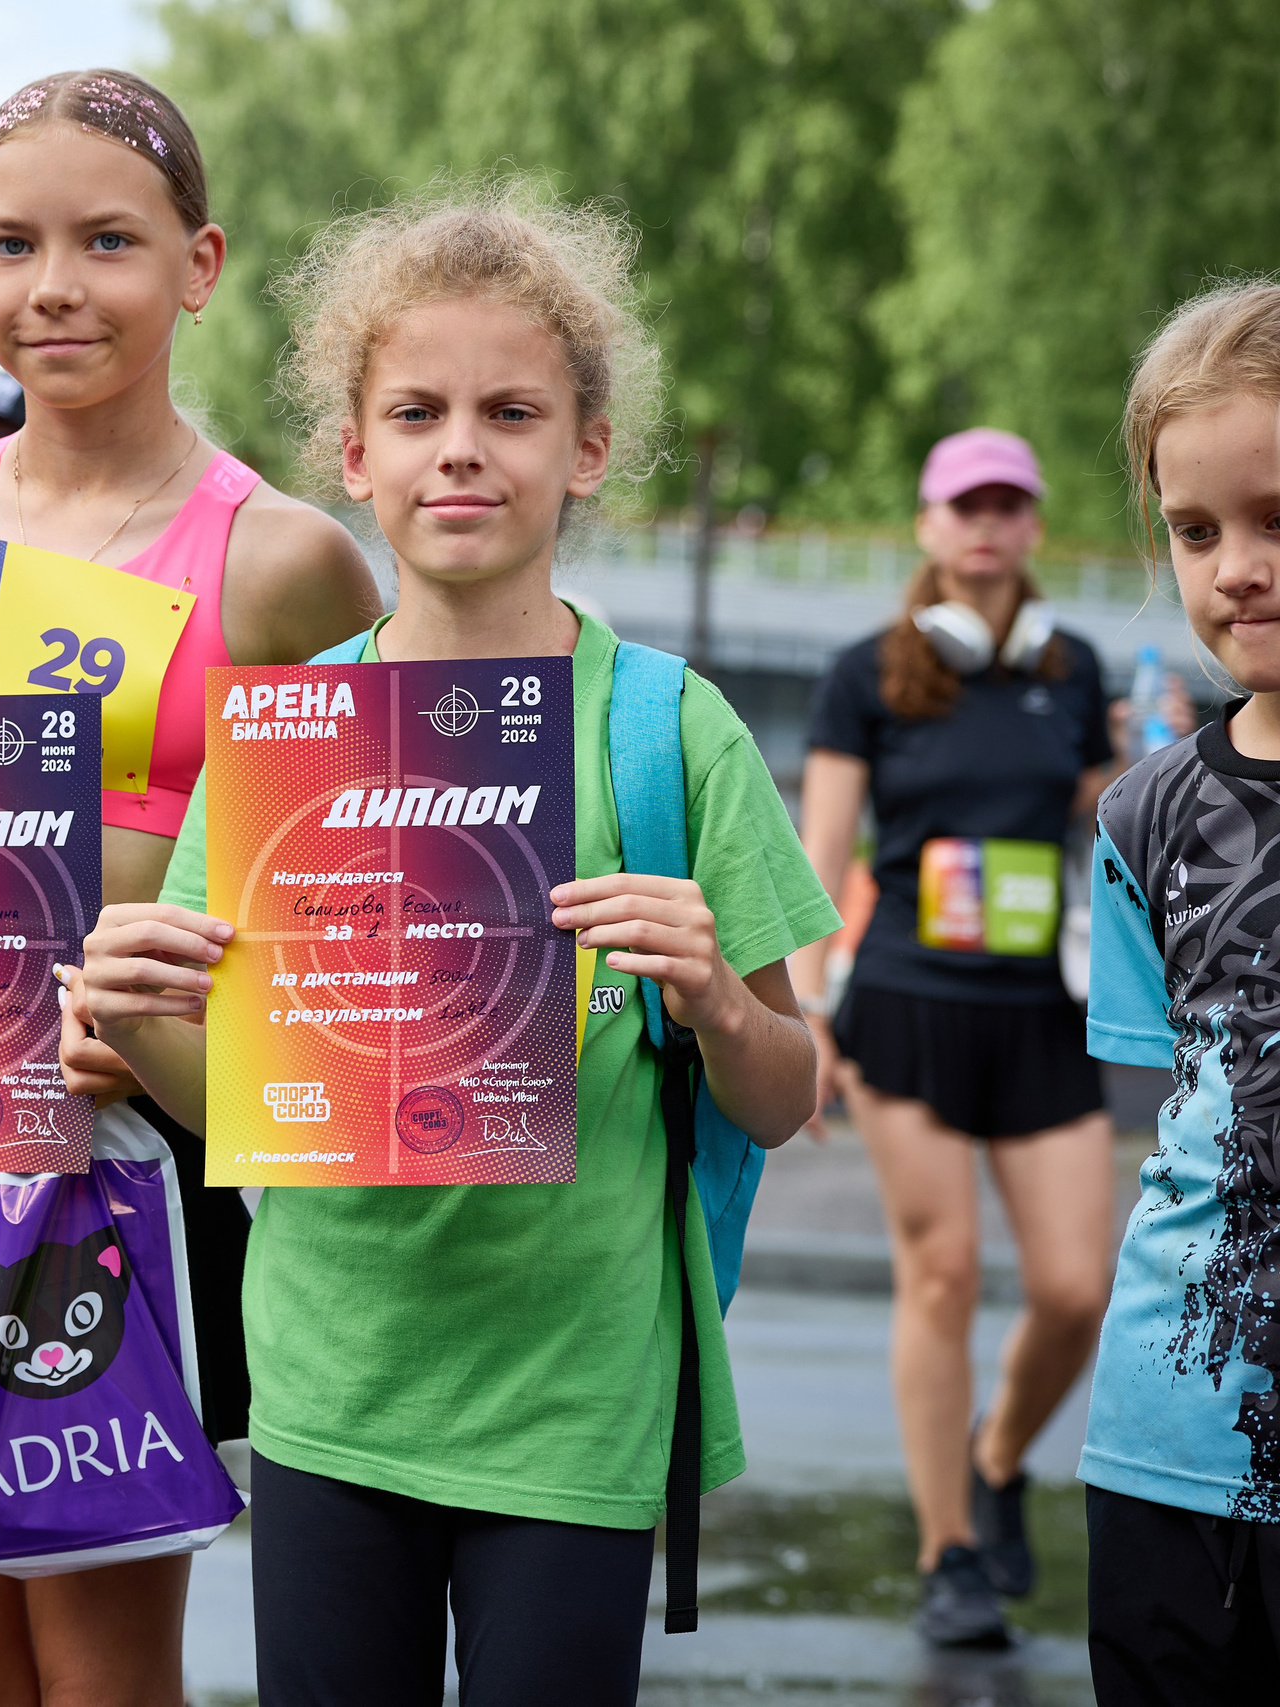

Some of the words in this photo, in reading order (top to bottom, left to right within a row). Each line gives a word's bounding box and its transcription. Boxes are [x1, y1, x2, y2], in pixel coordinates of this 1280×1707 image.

[27, 628, 126, 698] 29
[500, 676, 542, 707] 28
[222, 682, 356, 720] АРЕНА
[41, 710, 76, 739] 28
[231, 720, 338, 741] БИАТЛОНА
[501, 729, 537, 743] 2026
[41, 759, 71, 772] 2026
[321, 785, 542, 828] ДИПЛОМ
[272, 871, 404, 888] Награждается
[323, 924, 353, 941] за
[367, 921, 380, 938] 1
[405, 923, 484, 939] место
[271, 974, 297, 987] на
[301, 971, 419, 988] дистанции
[270, 1010, 281, 1023] с
[285, 1007, 424, 1026] результатом
[481, 1060, 529, 1075] Директор
[1, 1074, 19, 1085] АНО
[458, 1076, 480, 1087] АНО
[482, 1076, 520, 1091] «Спорт
[521, 1076, 554, 1088] Союз»
[11, 1089, 42, 1099] Шевель
[43, 1089, 66, 1100] Иван
[267, 1086, 319, 1102] СПОРТ
[473, 1091, 510, 1103] Шевель
[512, 1091, 539, 1103] Иван
[277, 1102, 327, 1118] СОЮЗ
[412, 1111, 441, 1122] СПОРТ
[423, 1119, 447, 1129] СОЮЗ
[235, 1152, 246, 1163] г.
[250, 1150, 356, 1165] Новосибирск
